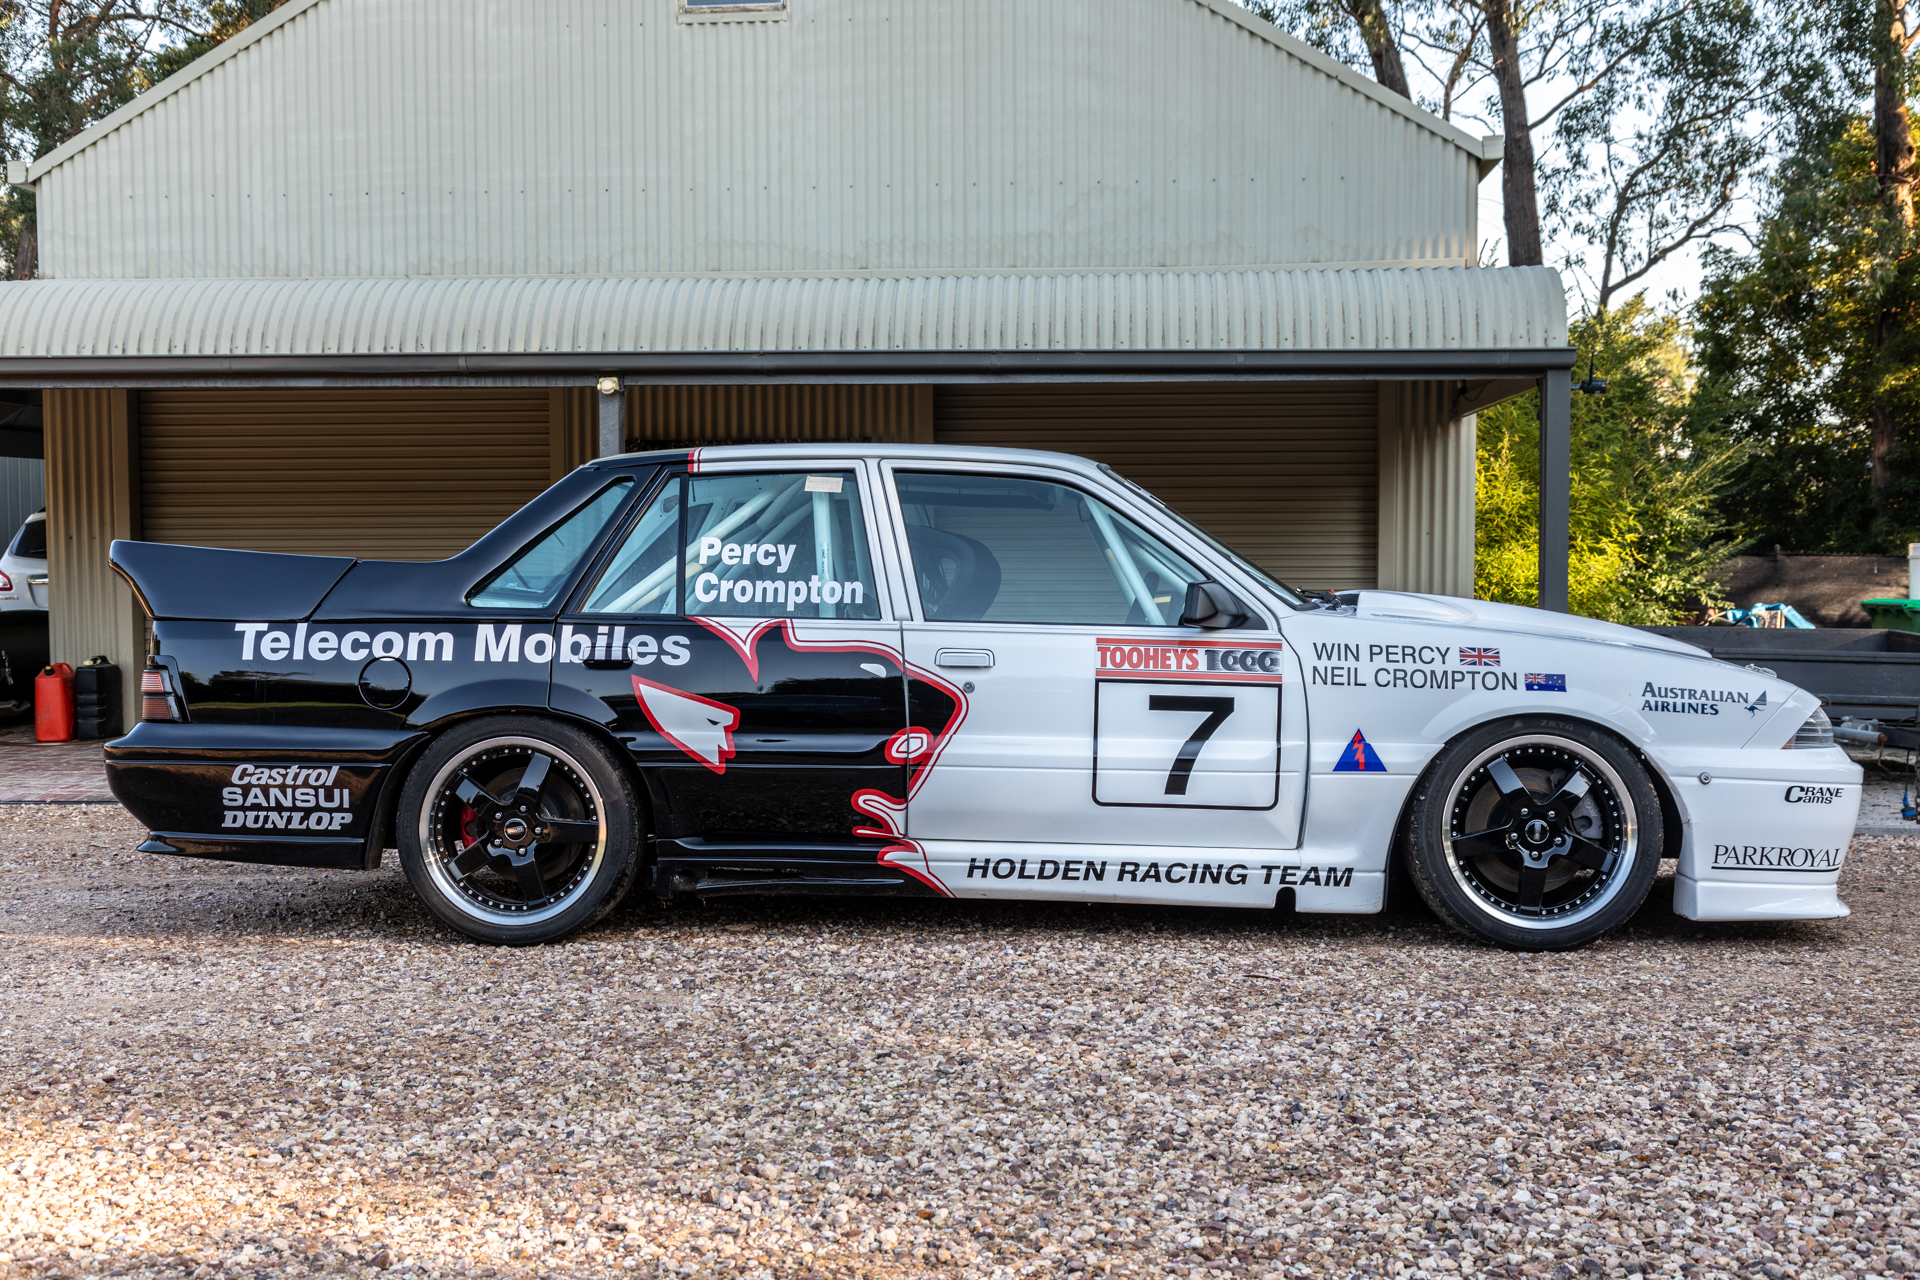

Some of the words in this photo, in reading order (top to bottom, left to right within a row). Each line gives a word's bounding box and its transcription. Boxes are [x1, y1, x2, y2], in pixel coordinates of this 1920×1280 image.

[698, 537, 797, 573] Percy
[694, 573, 864, 611] Crompton
[234, 622, 454, 662] Telecom
[474, 624, 691, 666] Mobiles
[1313, 642, 1361, 664] WIN
[1368, 643, 1451, 666] PERCY
[1097, 646, 1199, 671] TOOHEYS
[1205, 649, 1281, 672] 1000
[1312, 665, 1367, 687] NEIL
[1373, 668, 1518, 691] CROMPTON
[1642, 682, 1748, 703] AUSTRALIAN
[1641, 700, 1719, 715] AIRLINES
[1148, 695, 1235, 796] 7
[231, 764, 339, 785] Castrol
[222, 787, 350, 808] SANSUI
[1784, 785, 1844, 804] CRANE
[221, 810, 353, 831] DUNLOP
[1713, 845, 1842, 868] PARKROYAL
[966, 857, 1108, 882] HOLDEN
[1117, 862, 1249, 885] RACING
[1260, 865, 1354, 888] TEAM
